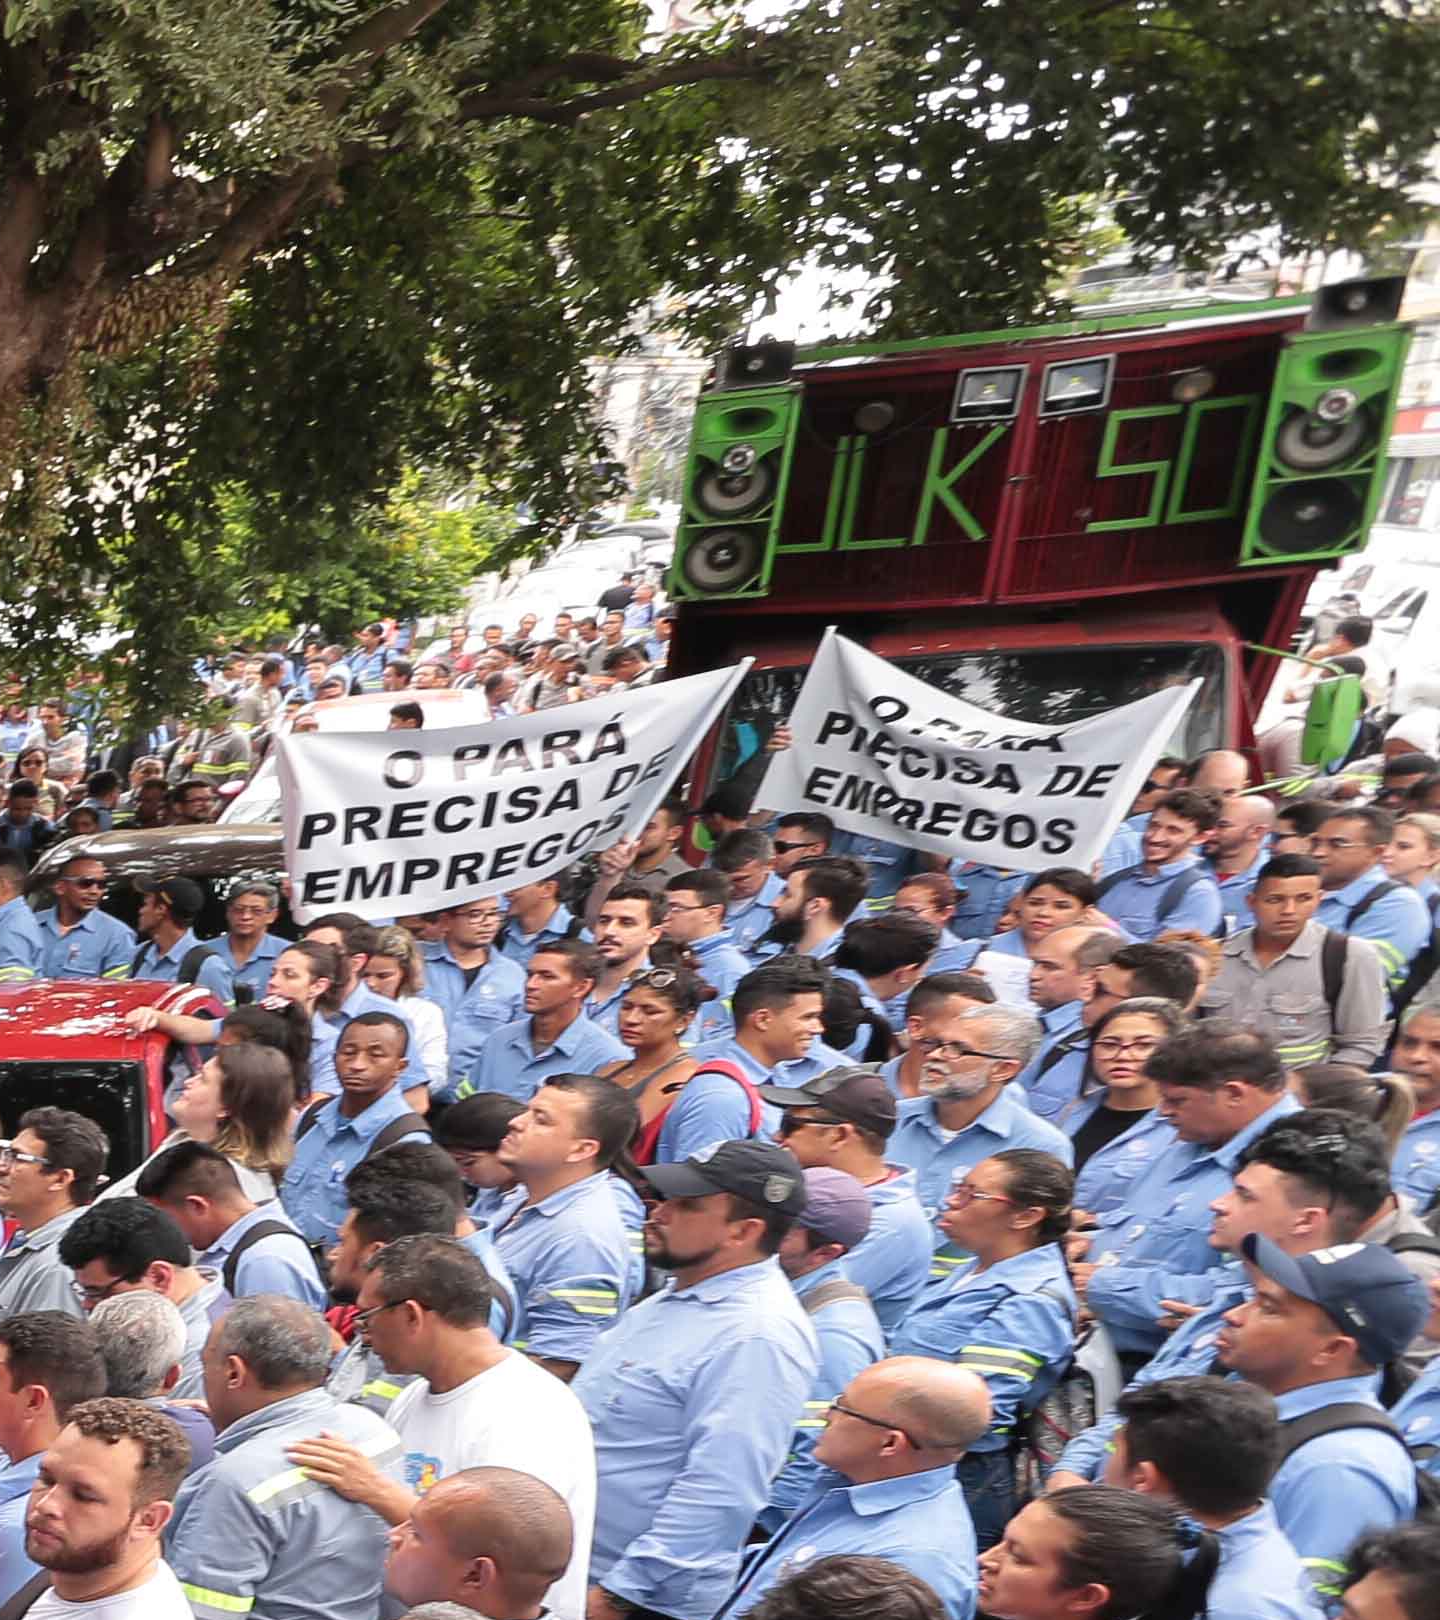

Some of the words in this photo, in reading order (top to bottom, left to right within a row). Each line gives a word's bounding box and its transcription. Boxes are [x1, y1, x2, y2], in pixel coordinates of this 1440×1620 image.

[383, 750, 424, 789] O
[452, 713, 626, 783] PARÁ
[1039, 763, 1121, 798] DE
[297, 779, 580, 850] PRECISA
[601, 743, 675, 801] DE
[802, 766, 1076, 855] EMPREGOS
[301, 802, 631, 906] EMPREGOS
